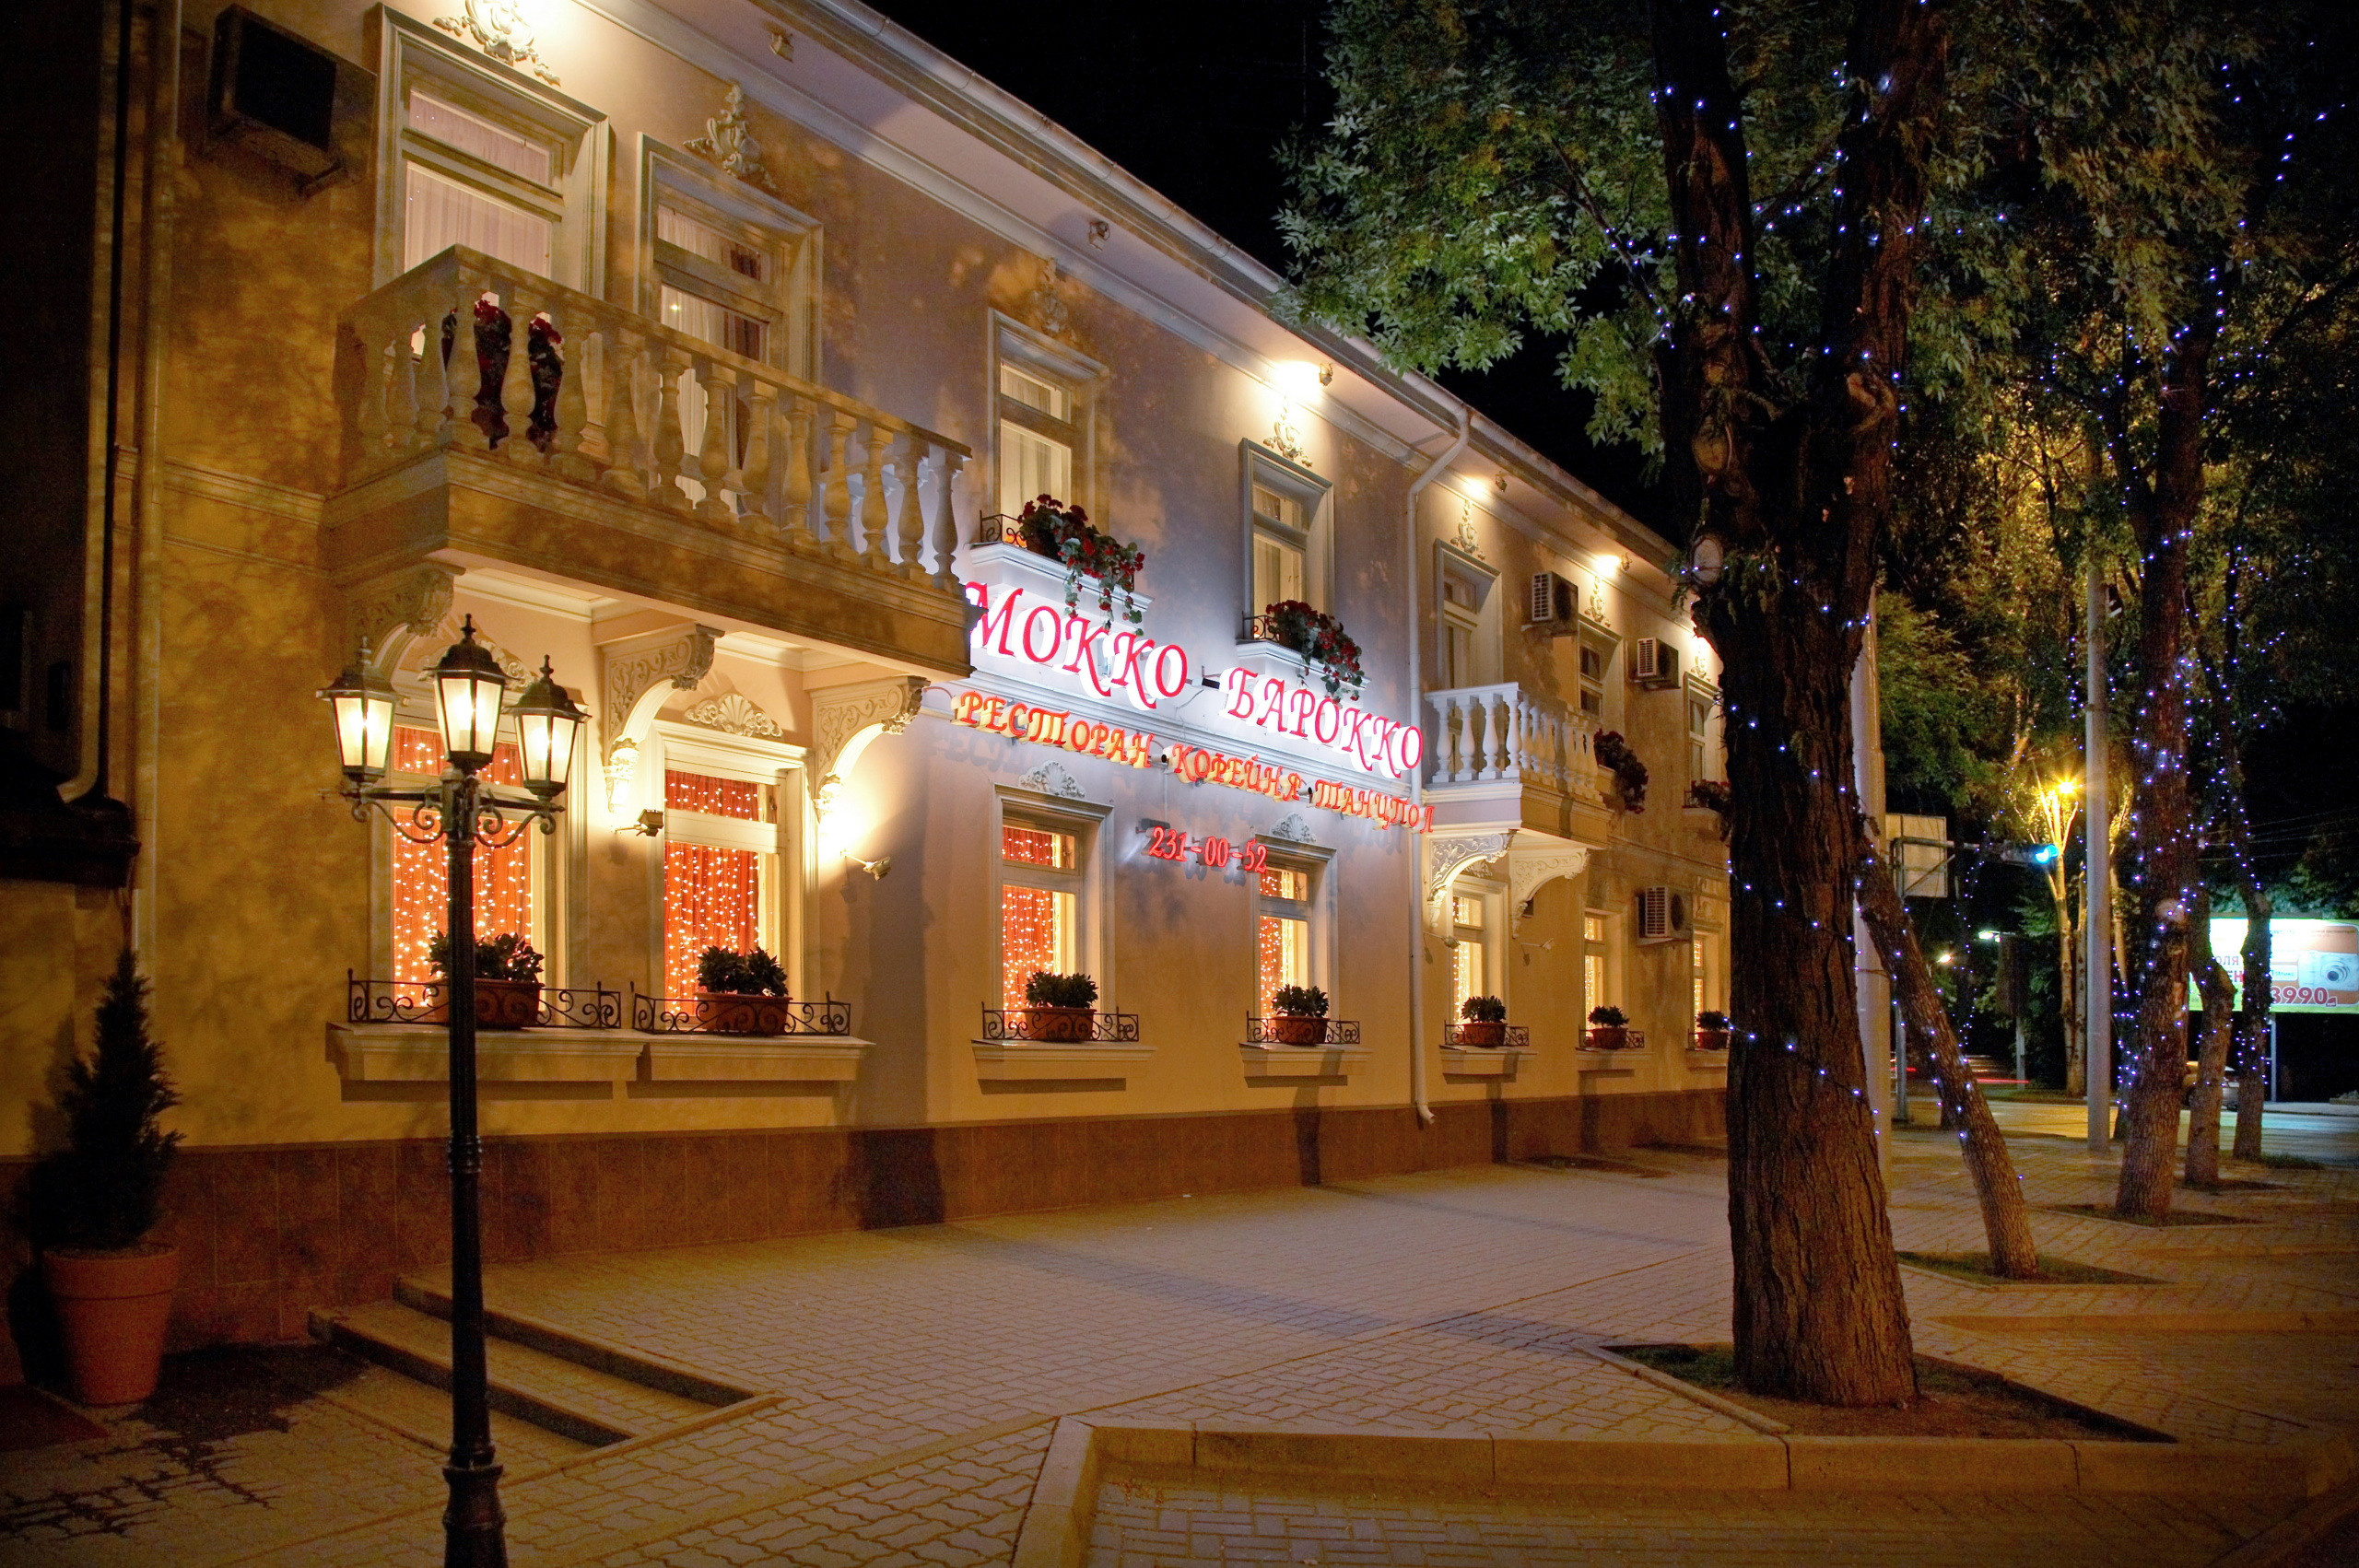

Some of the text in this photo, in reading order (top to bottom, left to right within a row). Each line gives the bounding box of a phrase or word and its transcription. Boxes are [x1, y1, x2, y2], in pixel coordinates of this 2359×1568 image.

[964, 580, 1424, 778] МОККО БАРОККО
[960, 690, 1436, 835] РЕСТОРАН КОФЕЙНЯ ТАНЦПОЛ
[1148, 826, 1268, 873] 231-00-52
